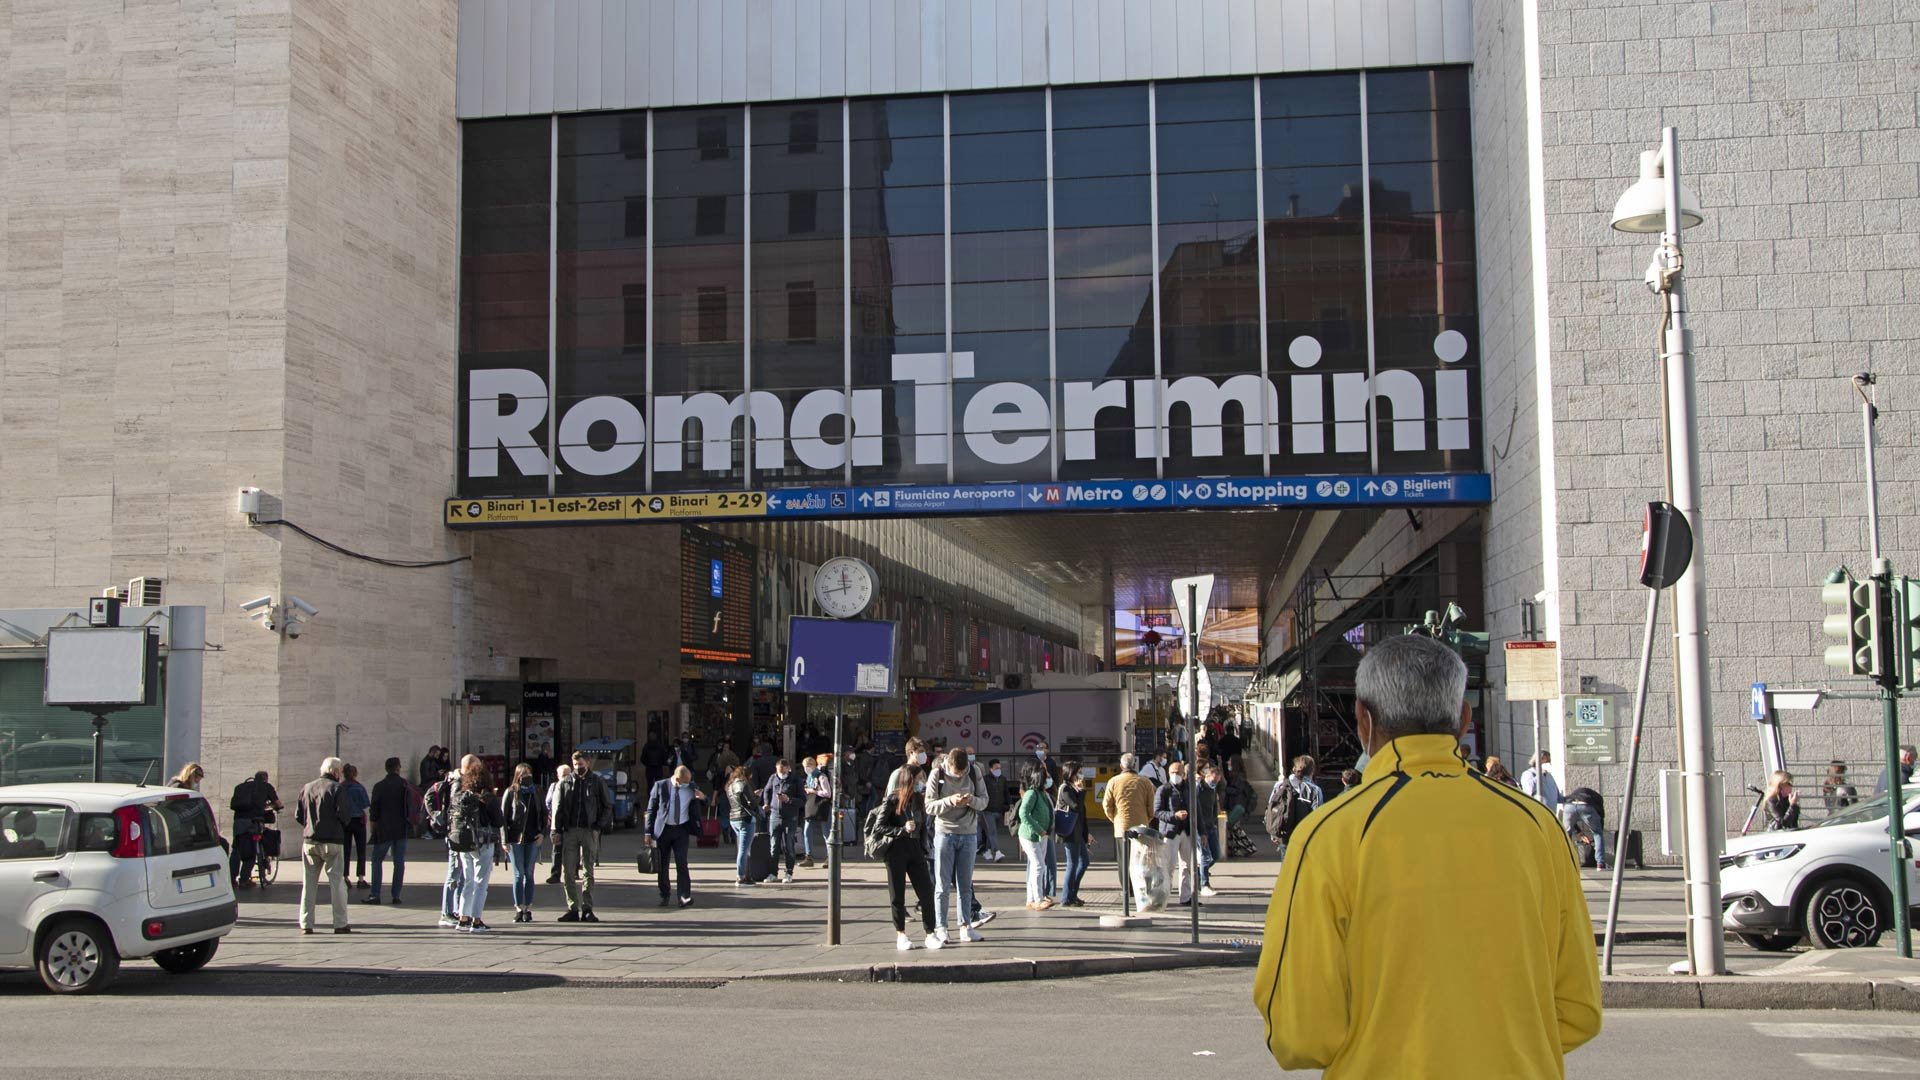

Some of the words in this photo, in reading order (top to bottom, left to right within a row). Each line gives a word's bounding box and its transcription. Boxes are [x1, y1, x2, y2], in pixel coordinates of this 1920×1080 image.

[1216, 481, 1307, 500] Shopping
[1403, 479, 1451, 491] Biglietti
[895, 489, 950, 501] Fiumicino
[953, 488, 1016, 500] Aeroporto
[1046, 489, 1059, 500] M
[1066, 486, 1123, 501] Metro
[487, 500, 524, 511] Binari
[669, 495, 708, 507] Binari
[718, 493, 763, 509] 2-29
[923, 500, 945, 509] Airport
[487, 513, 519, 521] Platforms
[669, 508, 702, 517] Platforms
[1581, 676, 1594, 685] 27
[524, 690, 545, 698] Coffee
[545, 690, 558, 698] Bar
